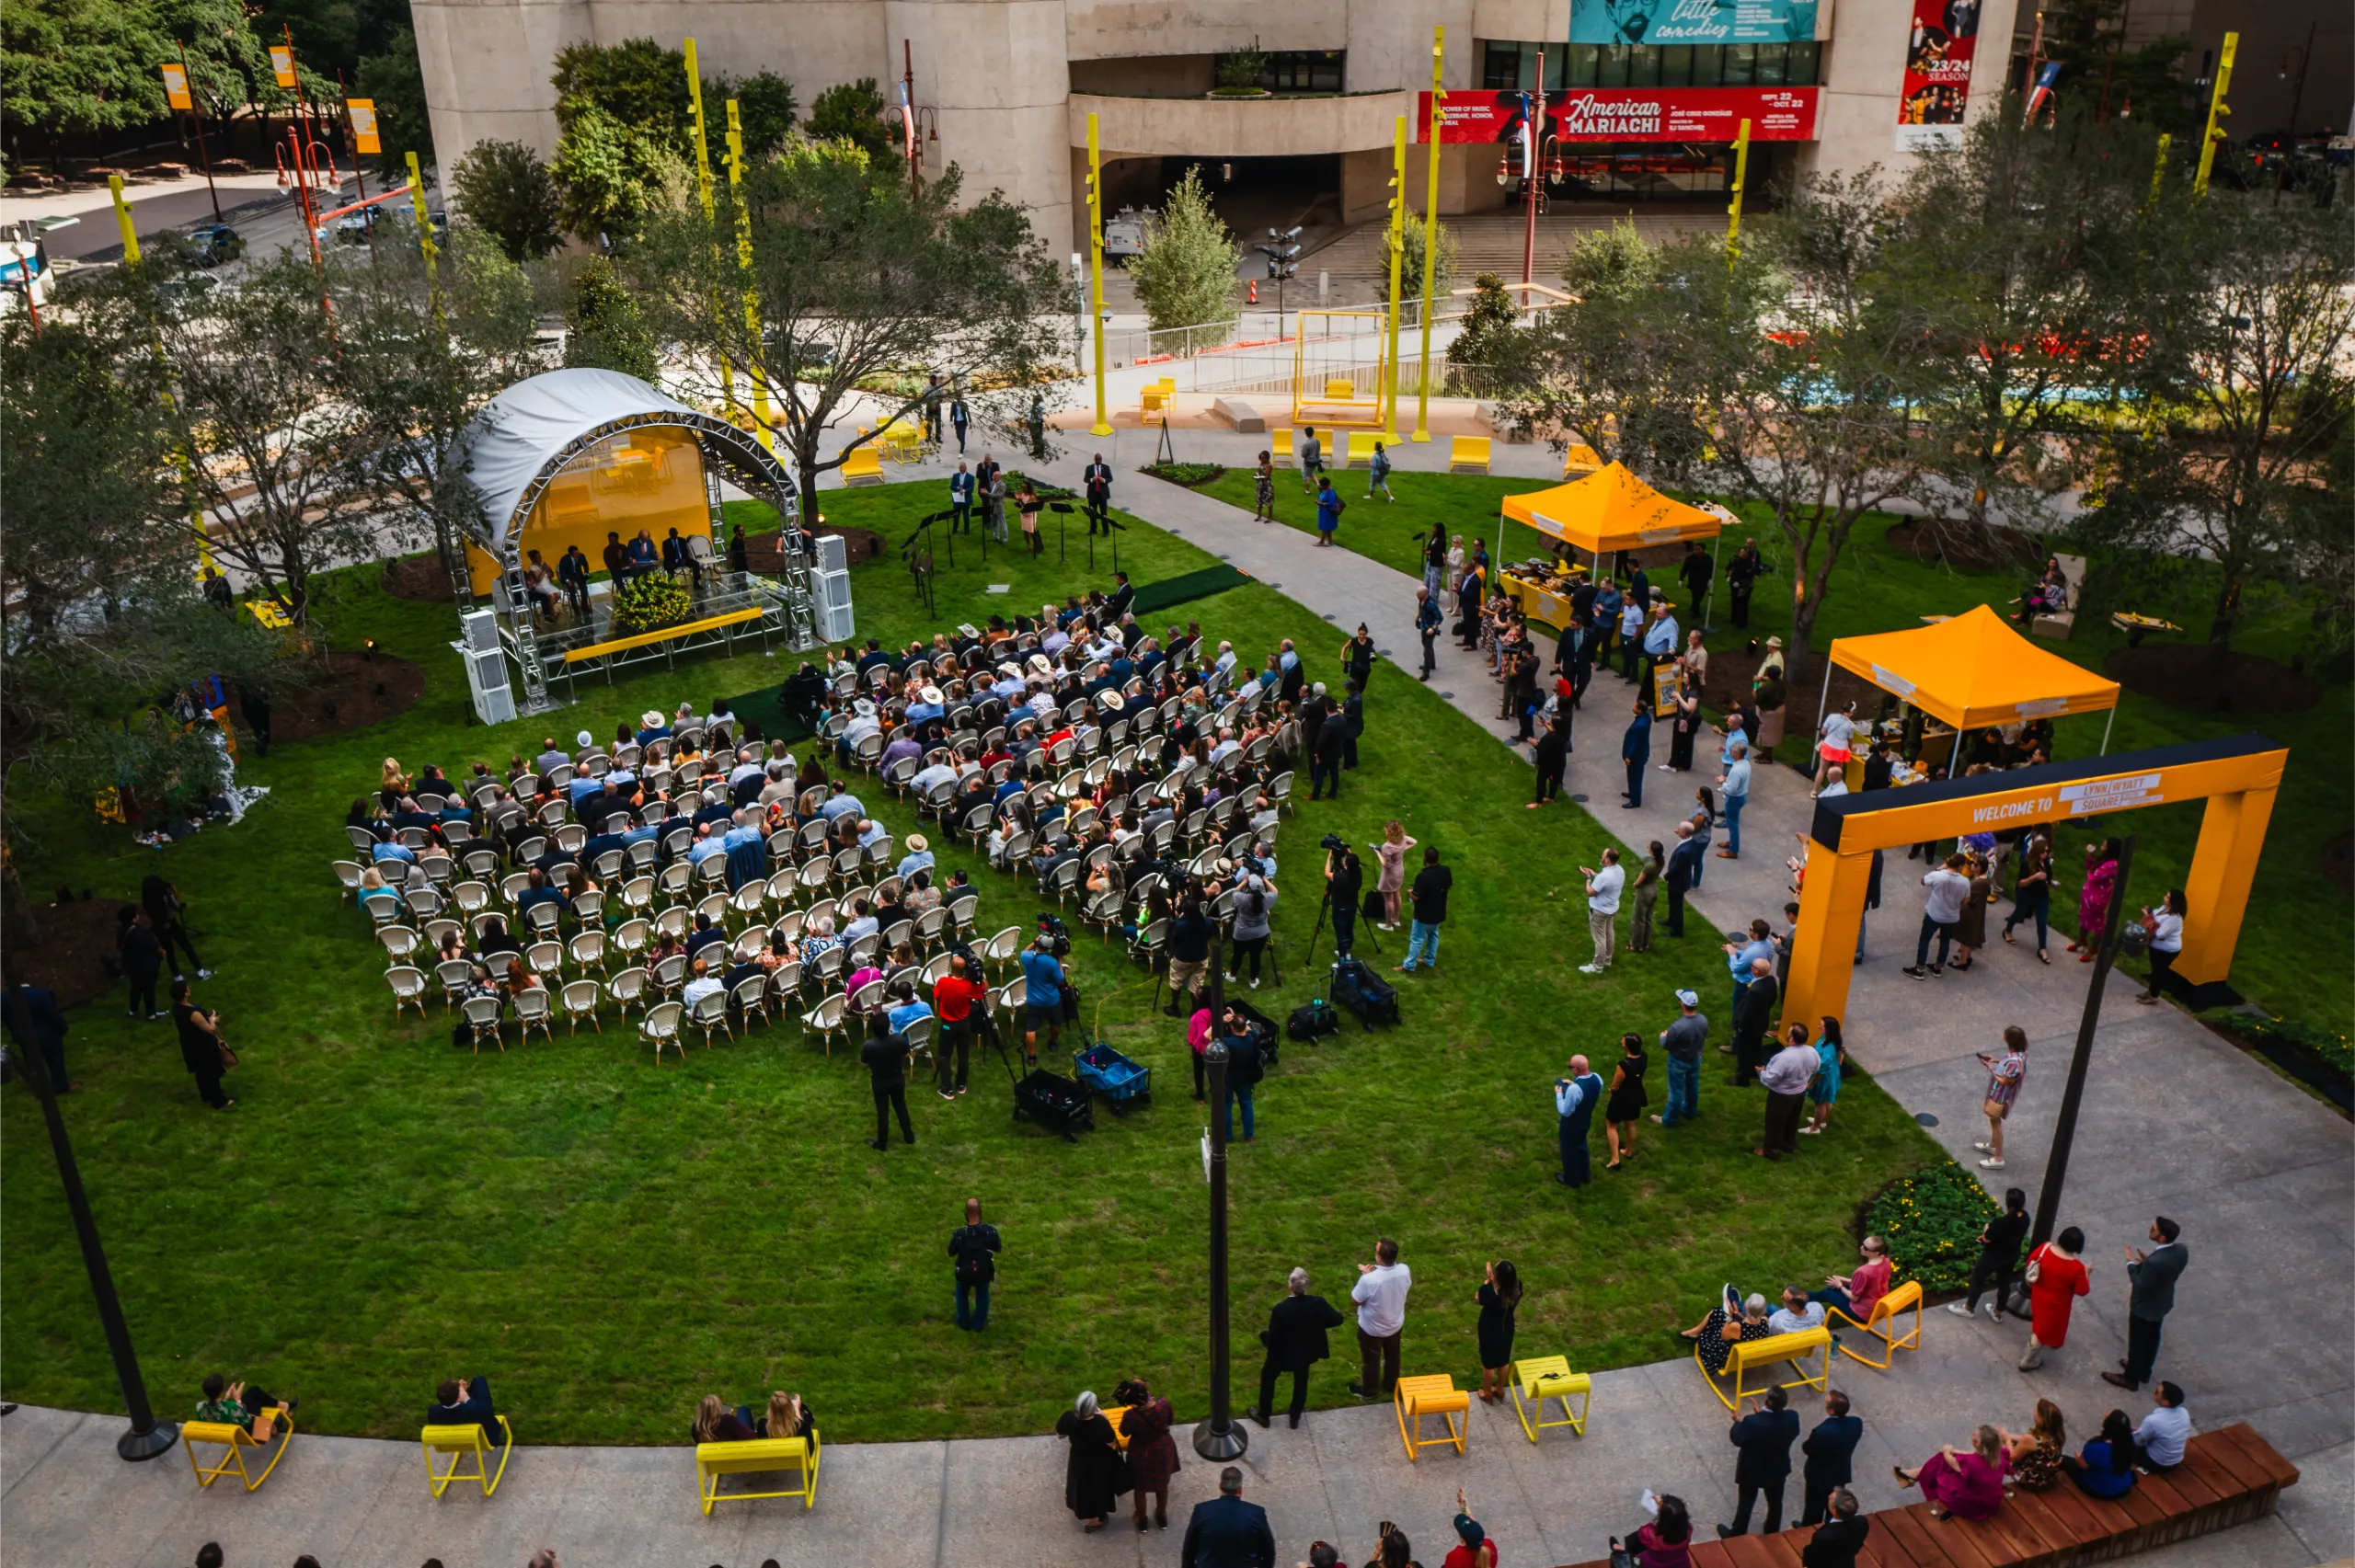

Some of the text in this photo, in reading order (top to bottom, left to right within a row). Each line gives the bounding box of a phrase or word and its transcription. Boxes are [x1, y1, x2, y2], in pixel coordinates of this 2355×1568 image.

[1671, 0, 1721, 21] little
[1656, 17, 1730, 38] comedies
[1930, 60, 1970, 72] 23/24
[1927, 72, 1968, 81] SEASON
[1779, 92, 1792, 100] 22
[1791, 99, 1803, 108] 22
[1565, 93, 1661, 121] American
[1569, 118, 1660, 133] MARIACHI
[2083, 783, 2108, 796] LYNN
[2110, 778, 2145, 792] WYATT
[1973, 797, 2052, 823] WELCOME TO
[2082, 795, 2120, 810] SQUARE
